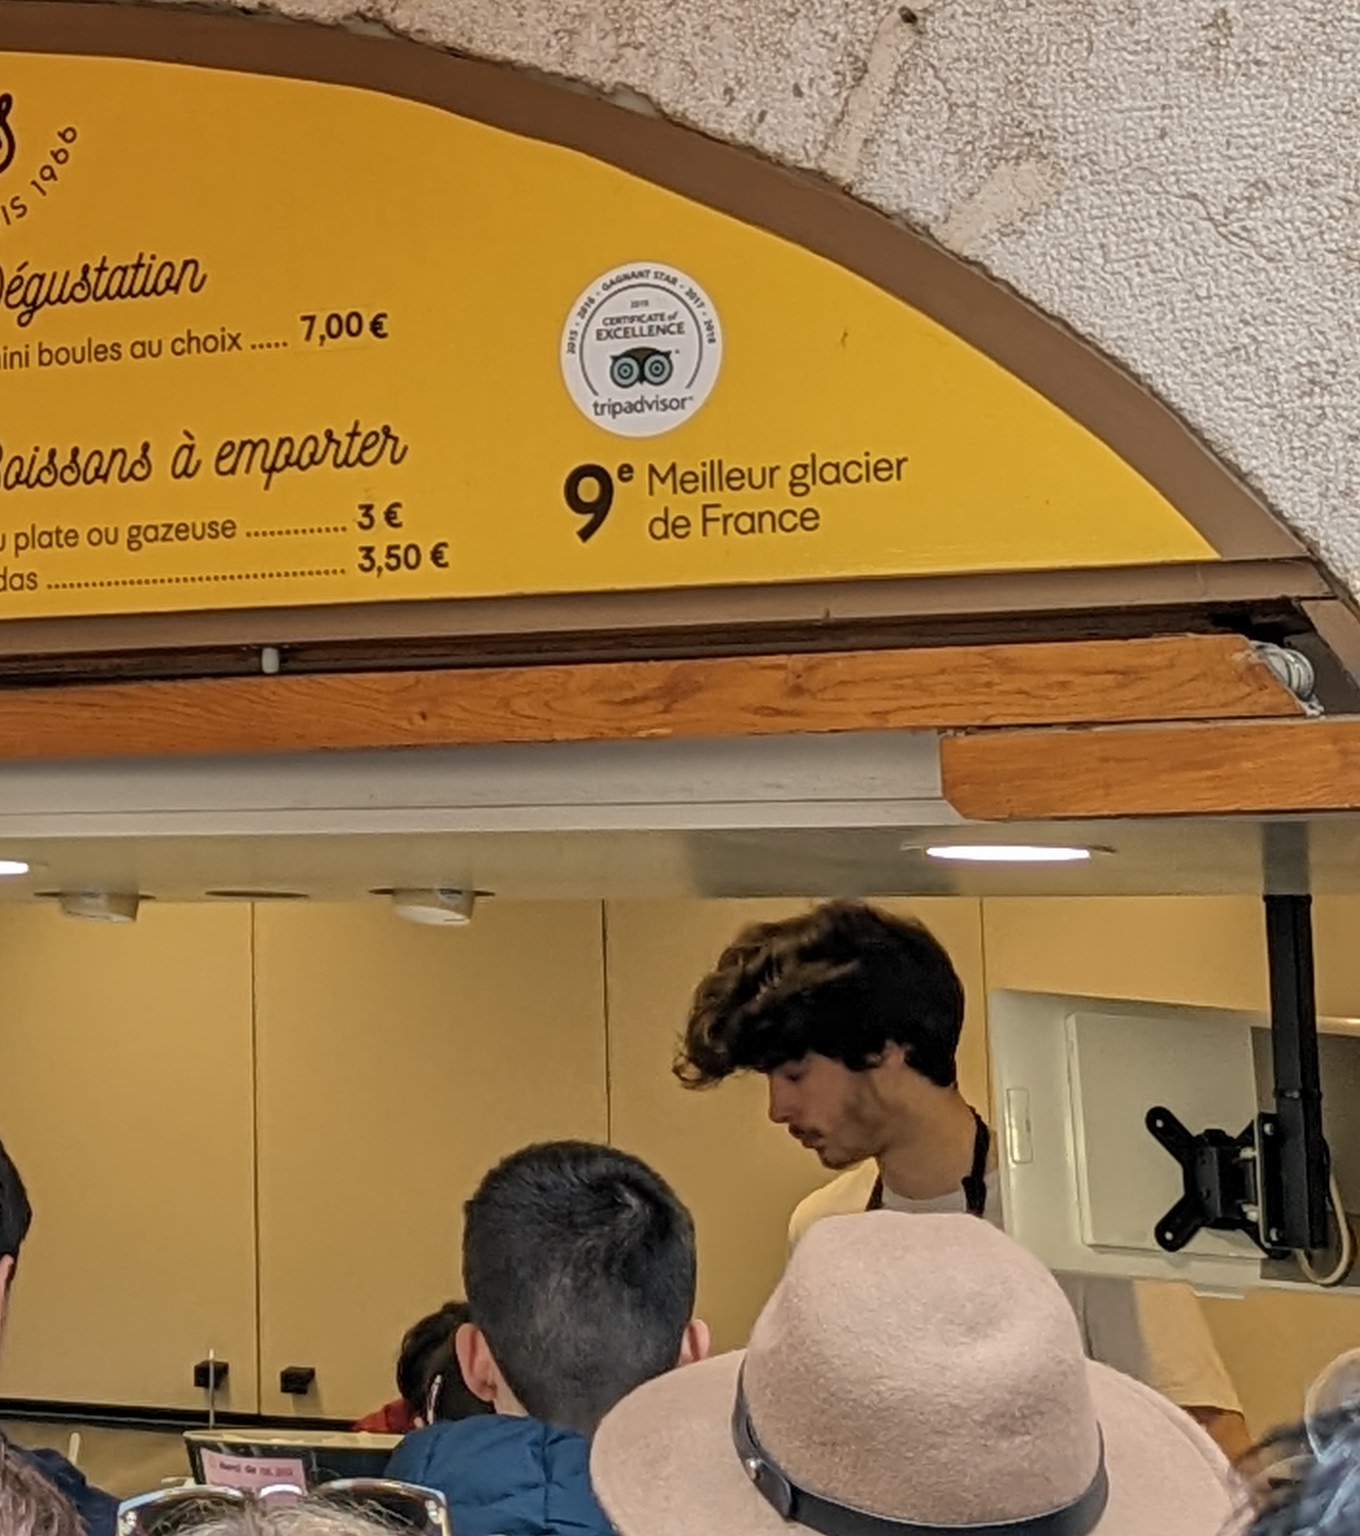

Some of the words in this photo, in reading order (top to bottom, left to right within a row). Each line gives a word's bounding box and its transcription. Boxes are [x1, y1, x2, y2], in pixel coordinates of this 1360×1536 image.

[30, 125, 78, 196] 1966
[602, 269, 651, 291] GAGNANT
[653, 270, 678, 286] STAR
[595, 321, 685, 341] EXCELLENCE
[602, 312, 665, 326] CERTIFICATE
[667, 311, 679, 321] of
[38, 336, 122, 367] boules
[130, 335, 162, 361] au
[170, 327, 243, 356] choix
[300, 311, 363, 347] 7,00
[592, 395, 688, 419] tripadvisor
[170, 429, 202, 480] à
[214, 419, 409, 491] emporter
[648, 459, 780, 496] Meilleur
[788, 452, 909, 497] glacier
[14, 521, 79, 558] plate
[86, 523, 119, 546] ou
[126, 517, 237, 551] gazeuse
[357, 503, 376, 530] 3
[383, 501, 403, 528] €
[648, 507, 691, 540] de
[702, 503, 820, 537] France
[357, 543, 421, 578] 3,50
[430, 542, 450, 568] €
